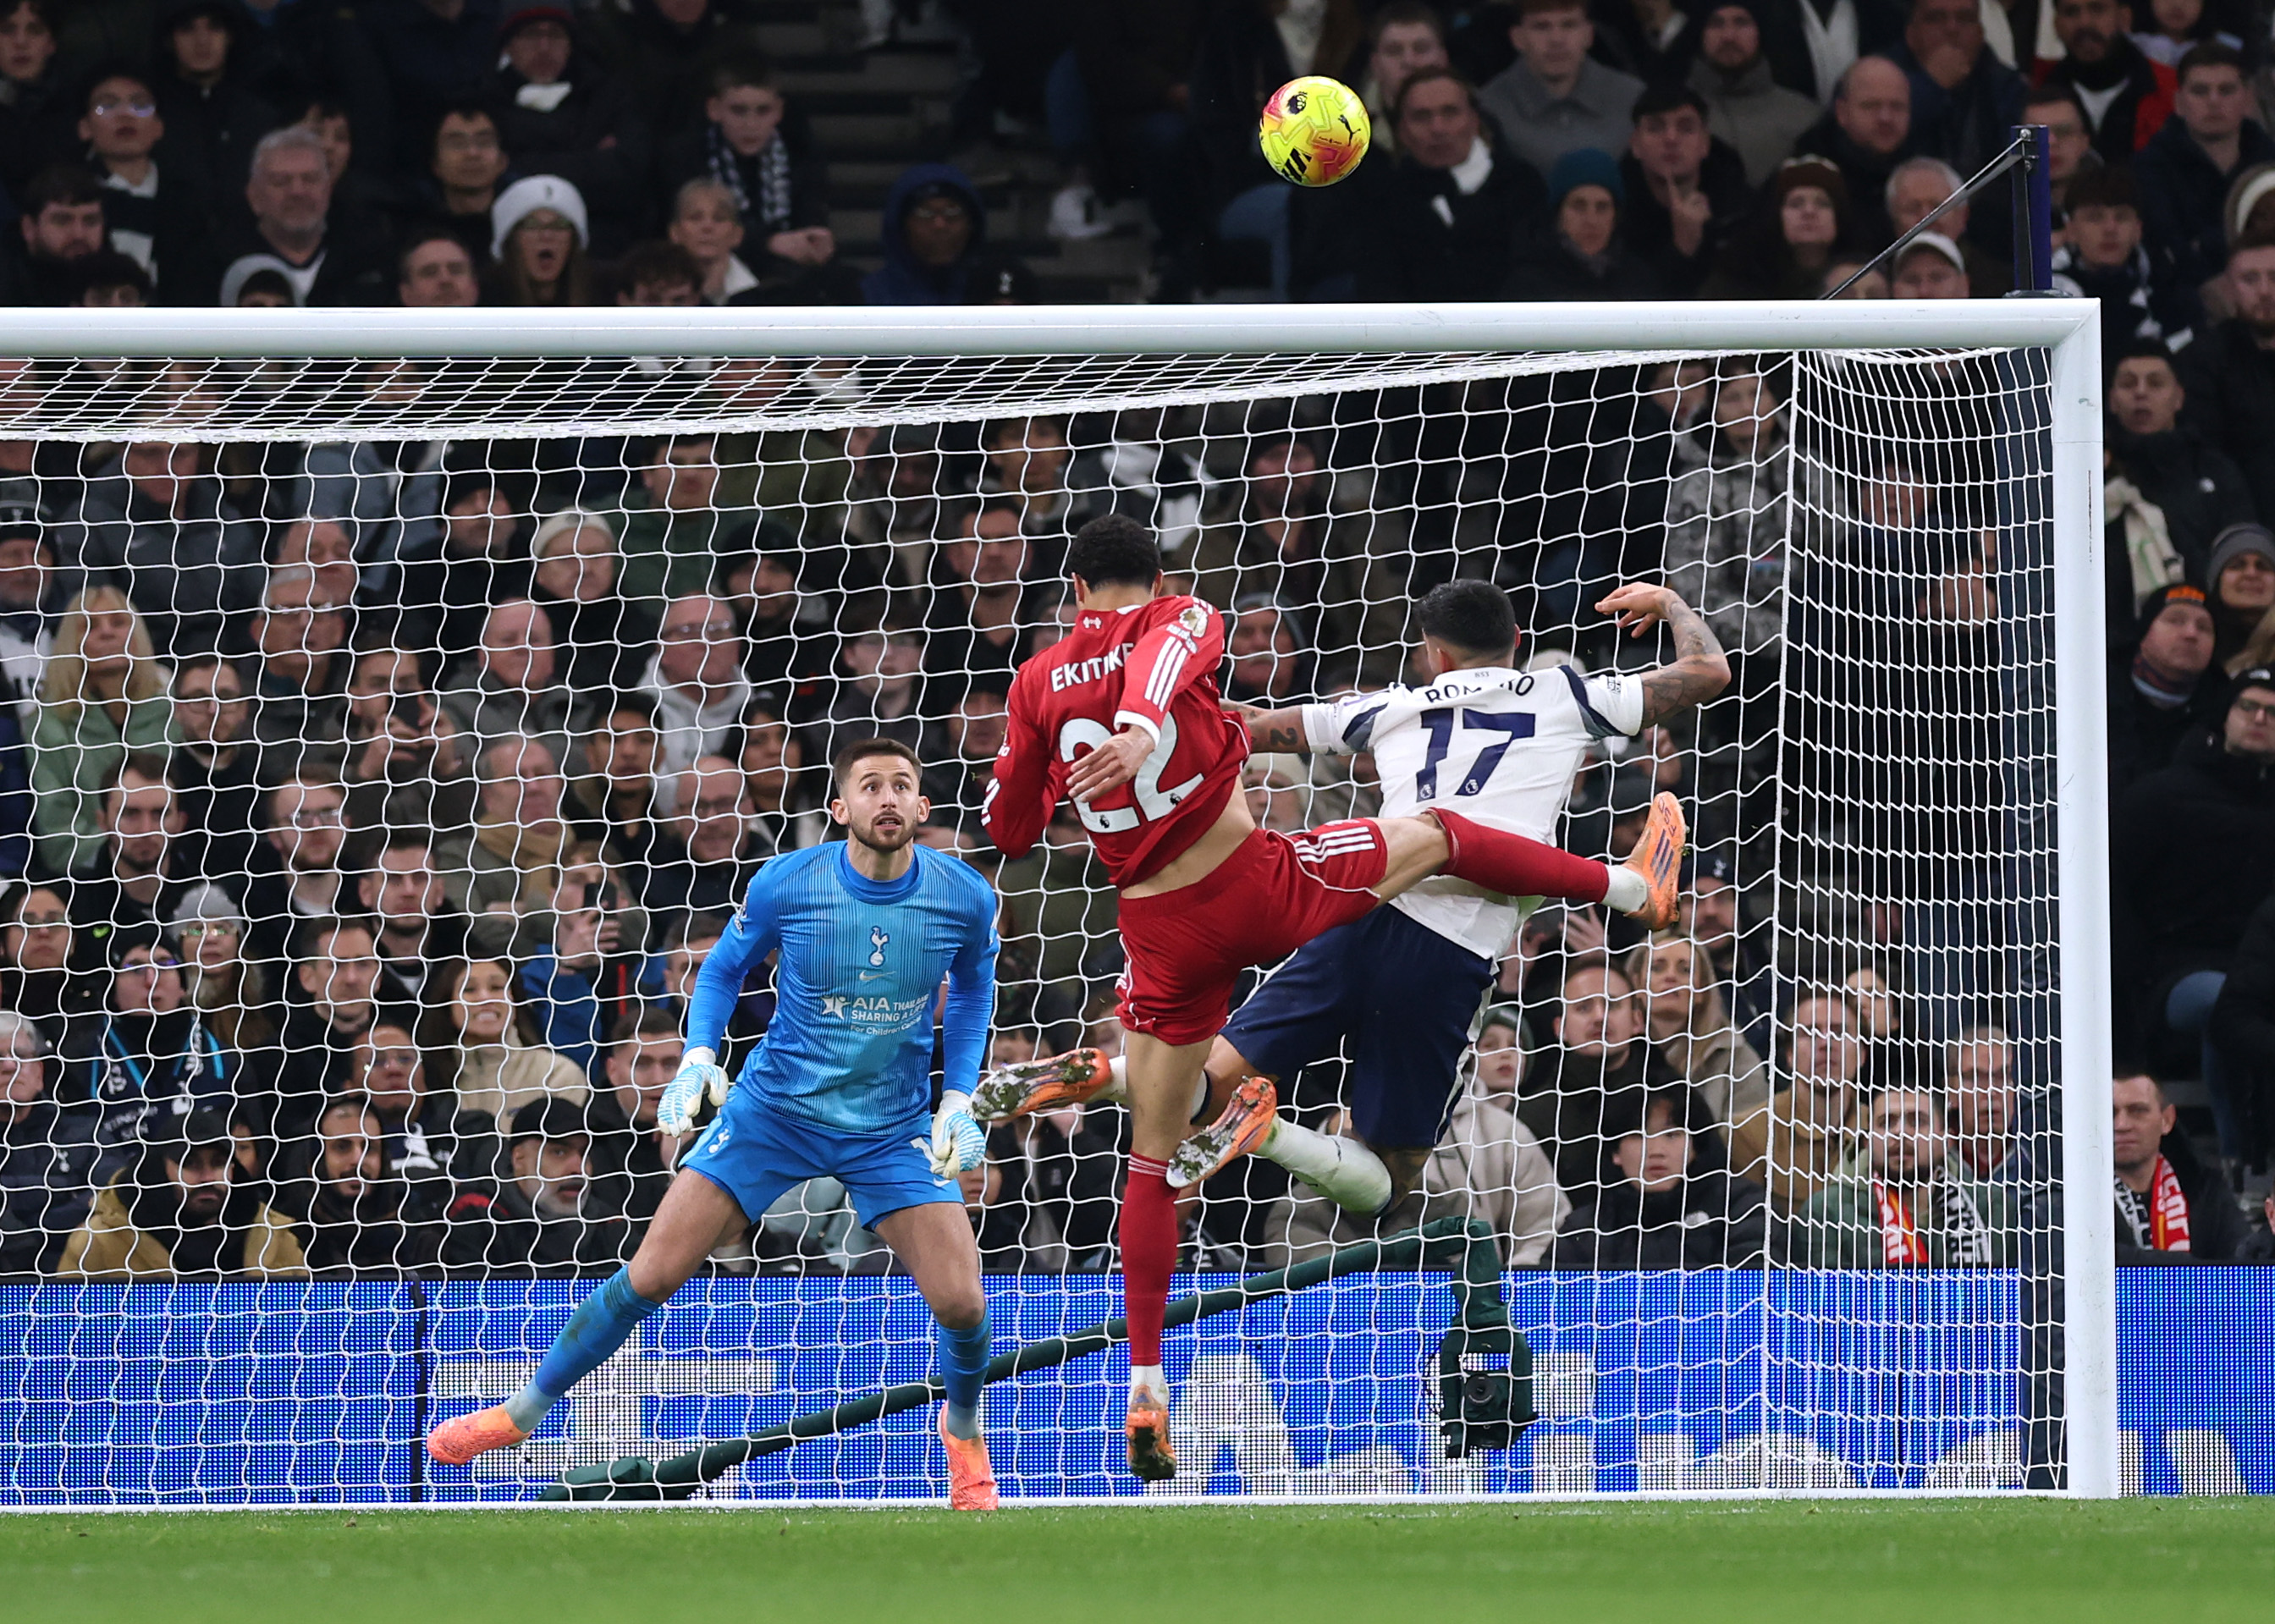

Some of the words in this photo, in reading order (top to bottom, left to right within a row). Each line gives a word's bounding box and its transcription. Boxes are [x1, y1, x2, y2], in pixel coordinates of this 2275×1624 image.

[1416, 707, 1536, 802] 17
[1059, 711, 1205, 834] 22
[852, 997, 890, 1011] AIA
[893, 994, 929, 1011] THAILAND
[851, 1010, 900, 1022] SHARING
[901, 1012, 908, 1021] A
[866, 1026, 901, 1036] Children
